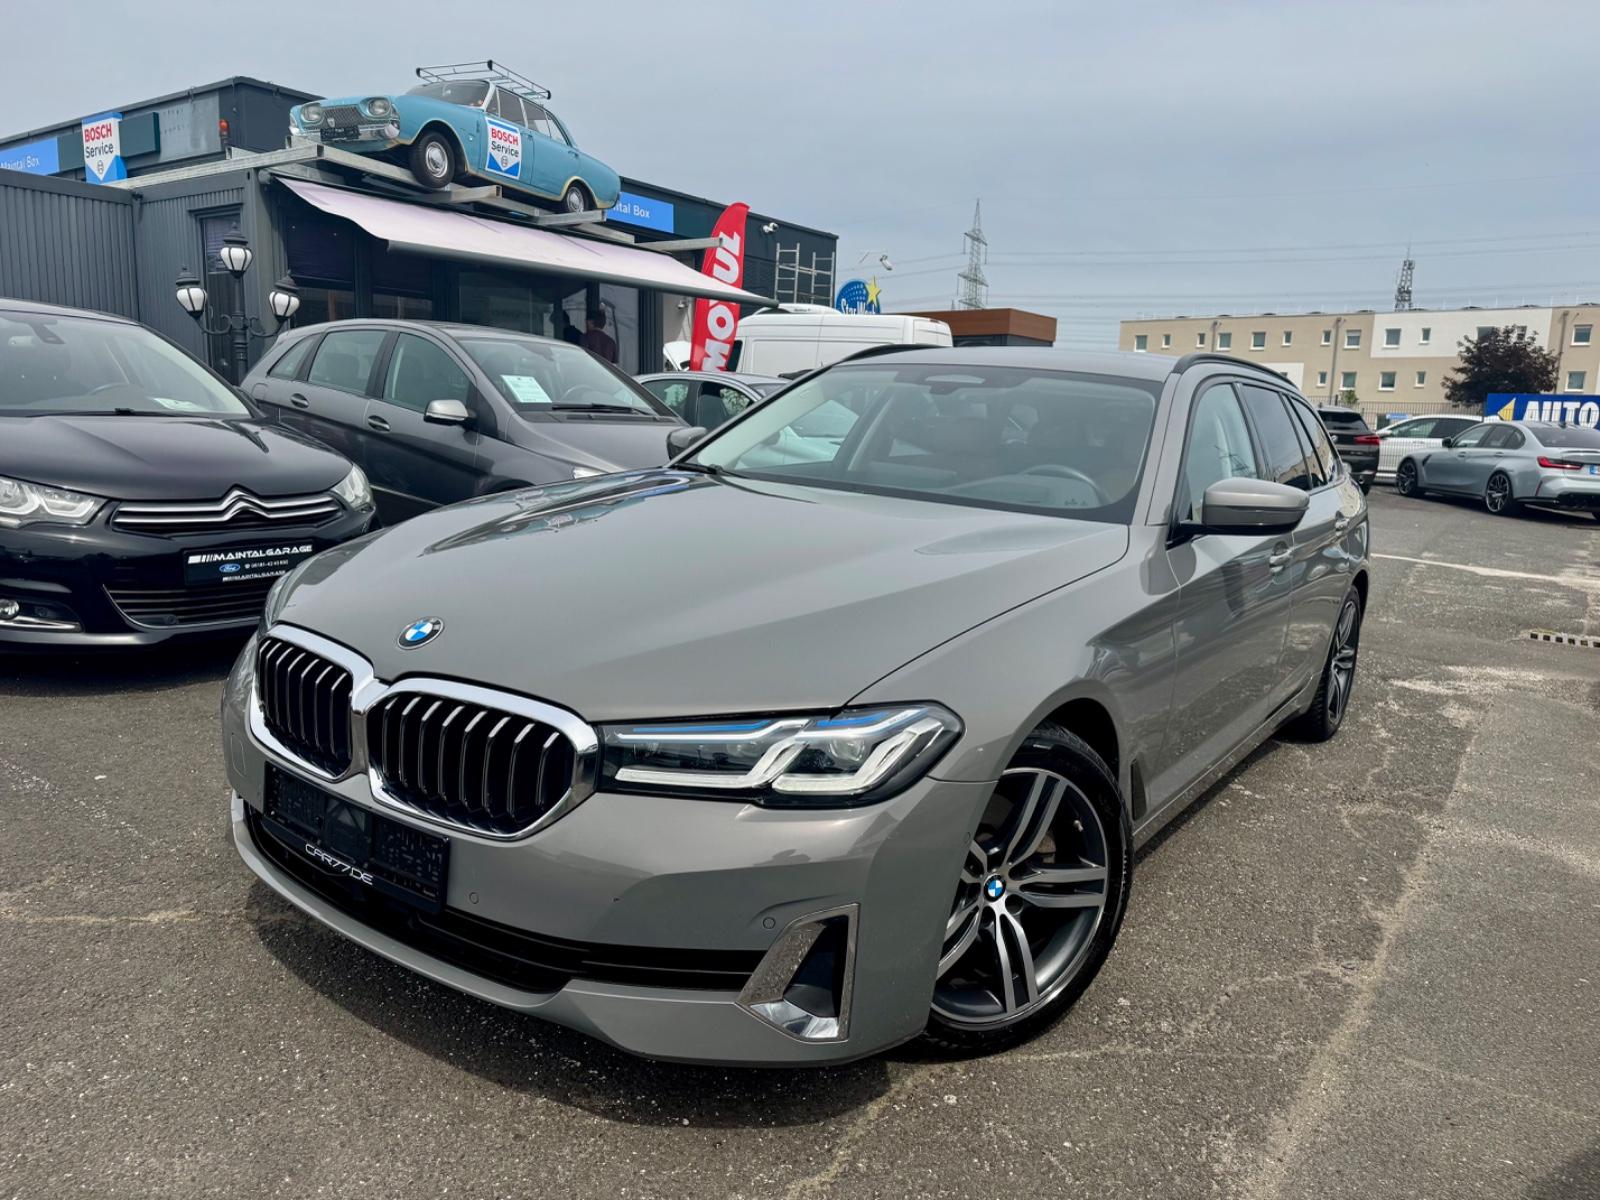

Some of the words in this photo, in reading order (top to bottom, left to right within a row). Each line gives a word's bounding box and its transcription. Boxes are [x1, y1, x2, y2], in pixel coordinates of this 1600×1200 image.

[84, 123, 112, 142] BOSCH
[491, 127, 518, 146] BOSCH
[85, 142, 114, 158] Service
[491, 141, 519, 158] Service
[26, 155, 41, 168] Box
[633, 204, 650, 219] Box
[702, 231, 741, 373] MOUL
[1522, 400, 1600, 429] AUTO
[213, 544, 313, 561] MAINTALGARAGE
